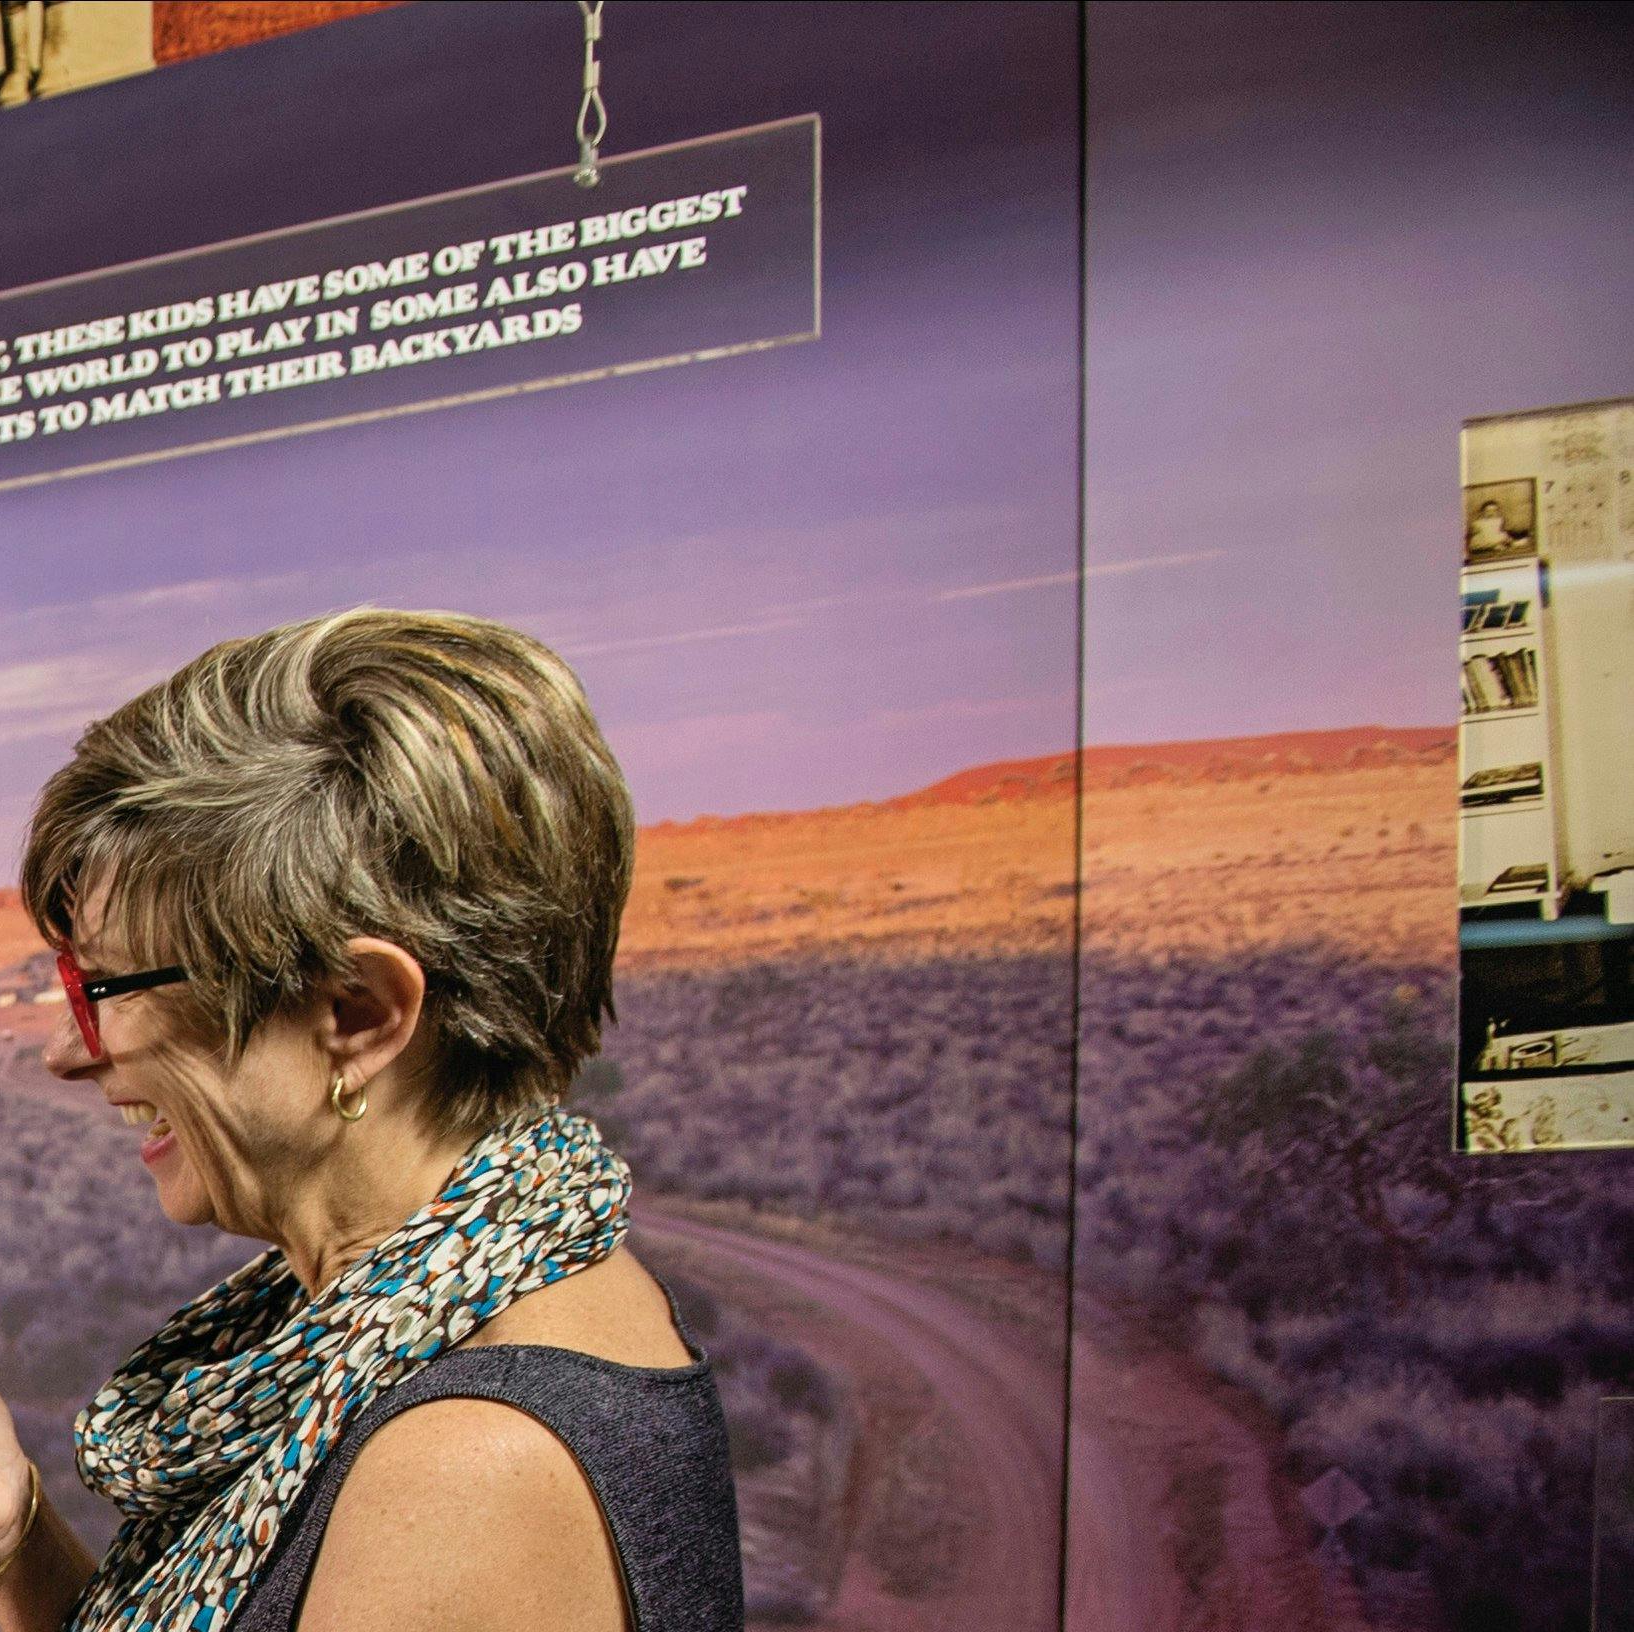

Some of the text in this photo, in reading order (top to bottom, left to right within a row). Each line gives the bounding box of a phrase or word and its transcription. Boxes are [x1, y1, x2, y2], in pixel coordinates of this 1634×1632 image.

[13, 316, 125, 364] THESE
[127, 296, 215, 341] KIDS
[217, 274, 321, 322] HAVE
[323, 251, 429, 300] SOME
[431, 240, 486, 277] OF
[488, 221, 576, 266] THE
[579, 185, 748, 248] BIGGEST
[24, 347, 159, 400] WORLD
[160, 334, 214, 373] TO
[214, 314, 312, 363] PLAY
[315, 306, 361, 342] IN
[369, 282, 479, 331] SOME
[482, 262, 587, 308] ALSO
[590, 235, 708, 288] HAVE
[37, 397, 89, 435] TO
[90, 373, 220, 426] MATCH
[224, 348, 348, 400] THEIR
[350, 302, 584, 376] BACKYARDS
